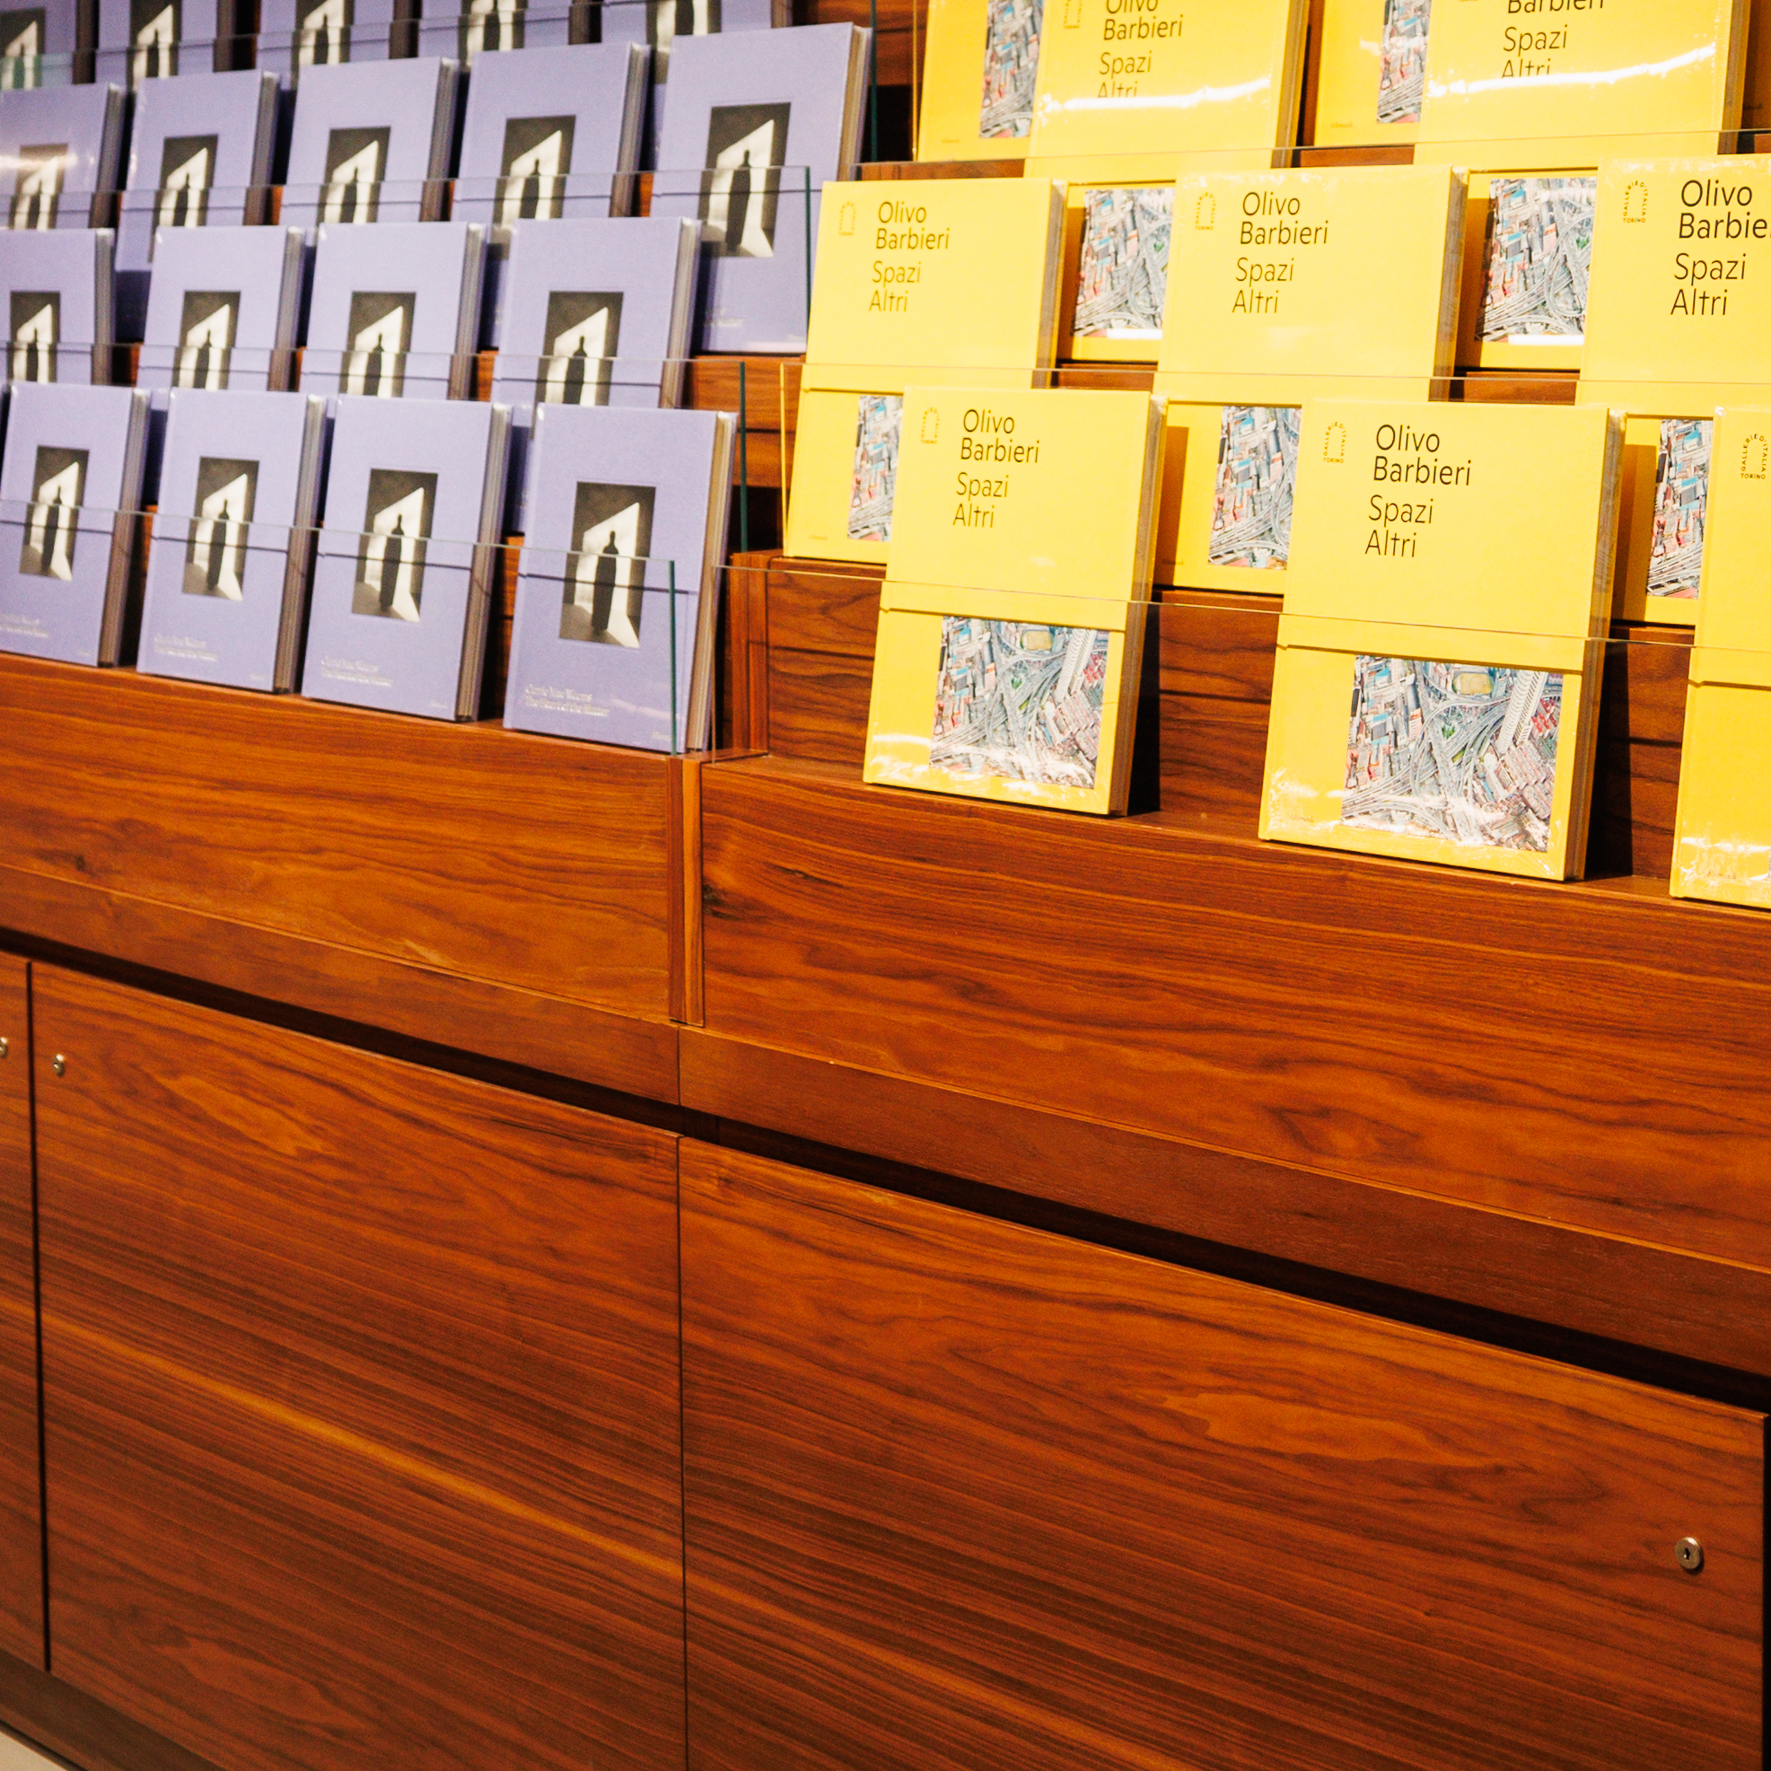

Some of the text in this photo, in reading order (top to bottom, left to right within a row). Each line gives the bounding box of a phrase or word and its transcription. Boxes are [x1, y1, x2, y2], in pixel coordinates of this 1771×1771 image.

[1103, 16, 1183, 41] Barbieri
[1503, 26, 1567, 57] Spazi
[1099, 51, 1151, 79] Spazi
[1501, 58, 1552, 79] Altri
[1242, 191, 1301, 217] Olivo
[1680, 178, 1753, 208] Olivo
[878, 201, 926, 224] Olivo
[875, 225, 949, 250] Barbieri
[1240, 220, 1328, 245] Barbieri
[872, 260, 921, 287] Spazi
[1235, 256, 1294, 287] Spazi
[1674, 252, 1746, 287] Spazi
[869, 289, 908, 313] Altri
[1232, 289, 1278, 314] Altri
[1670, 287, 1727, 316] Altri
[962, 408, 1015, 435] Olivo
[960, 436, 1039, 463] Barbieri
[1375, 423, 1441, 453] Olivo
[1741, 434, 1758, 471] GALLERIE
[1373, 455, 1471, 486] Barbieri
[956, 471, 1008, 501] Spazi
[952, 503, 994, 528] Altri
[1368, 494, 1433, 528] Spazi
[1364, 529, 1416, 558] Altri
